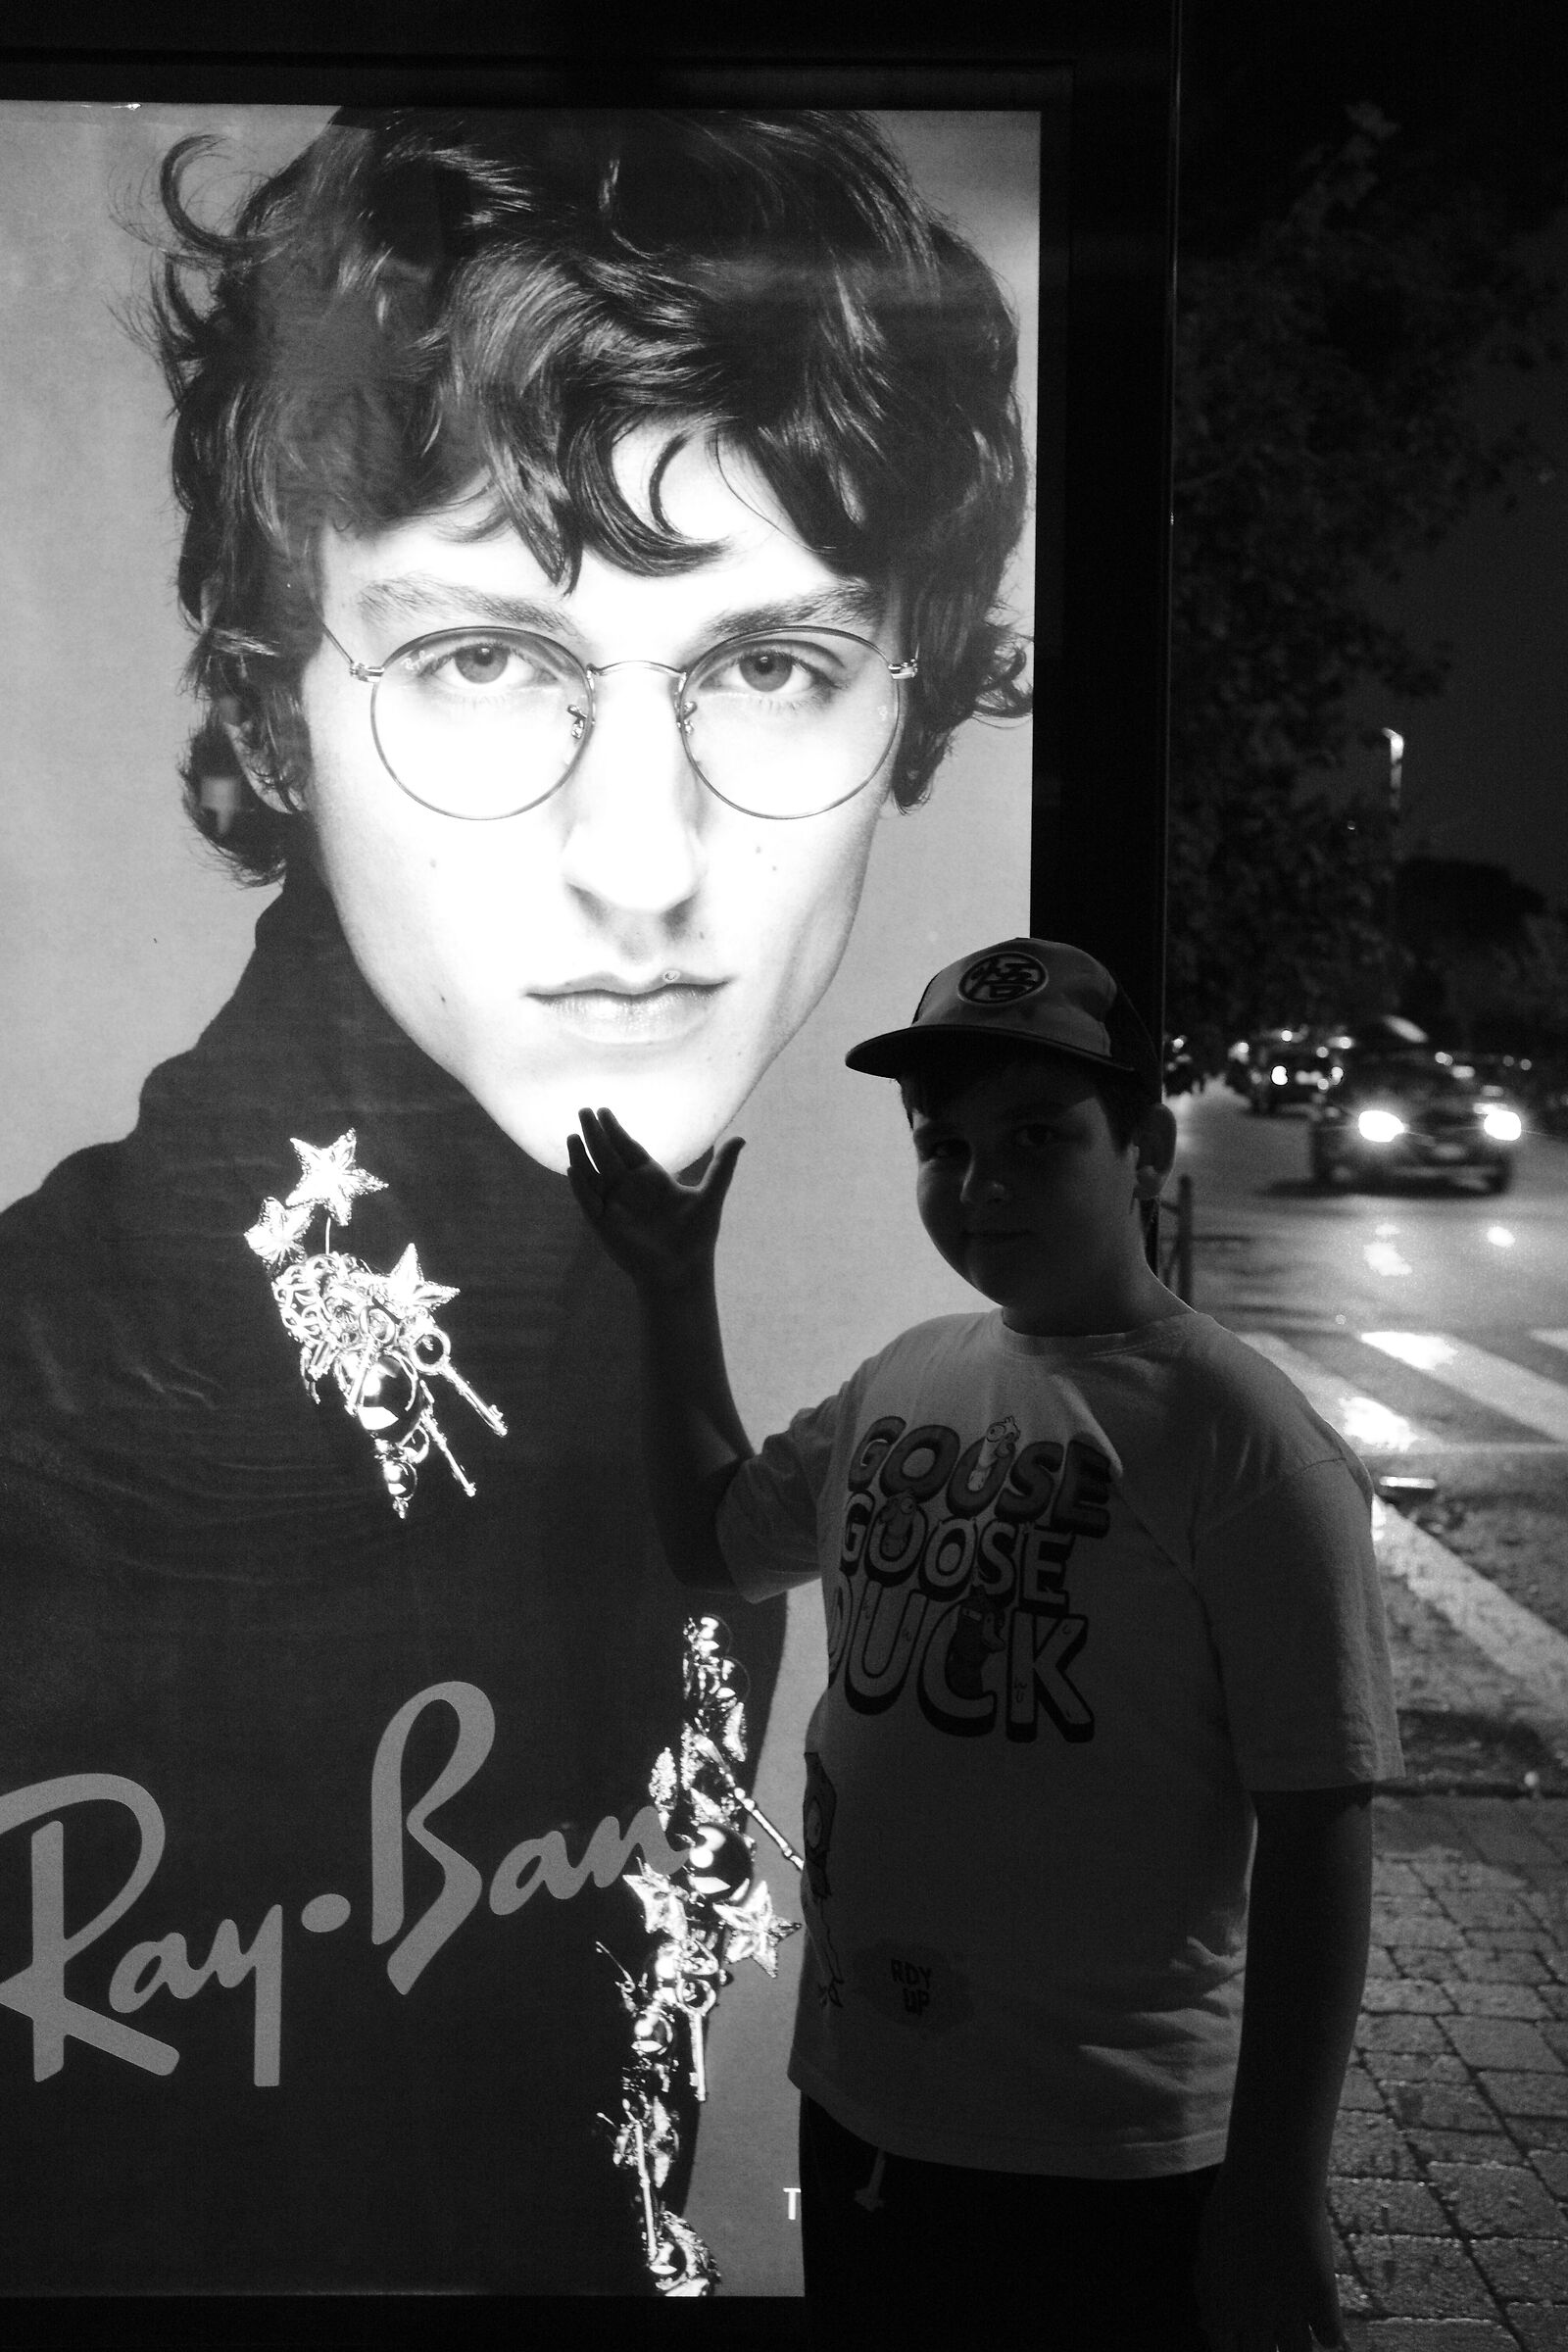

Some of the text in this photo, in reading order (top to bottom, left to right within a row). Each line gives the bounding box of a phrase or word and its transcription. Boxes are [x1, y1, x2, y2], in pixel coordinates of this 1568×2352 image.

[849, 1416, 1110, 1538] GOOSE
[841, 1489, 1076, 1617] GOOSE
[891, 1958, 931, 1989] RDY
[903, 1987, 930, 2016] UP
